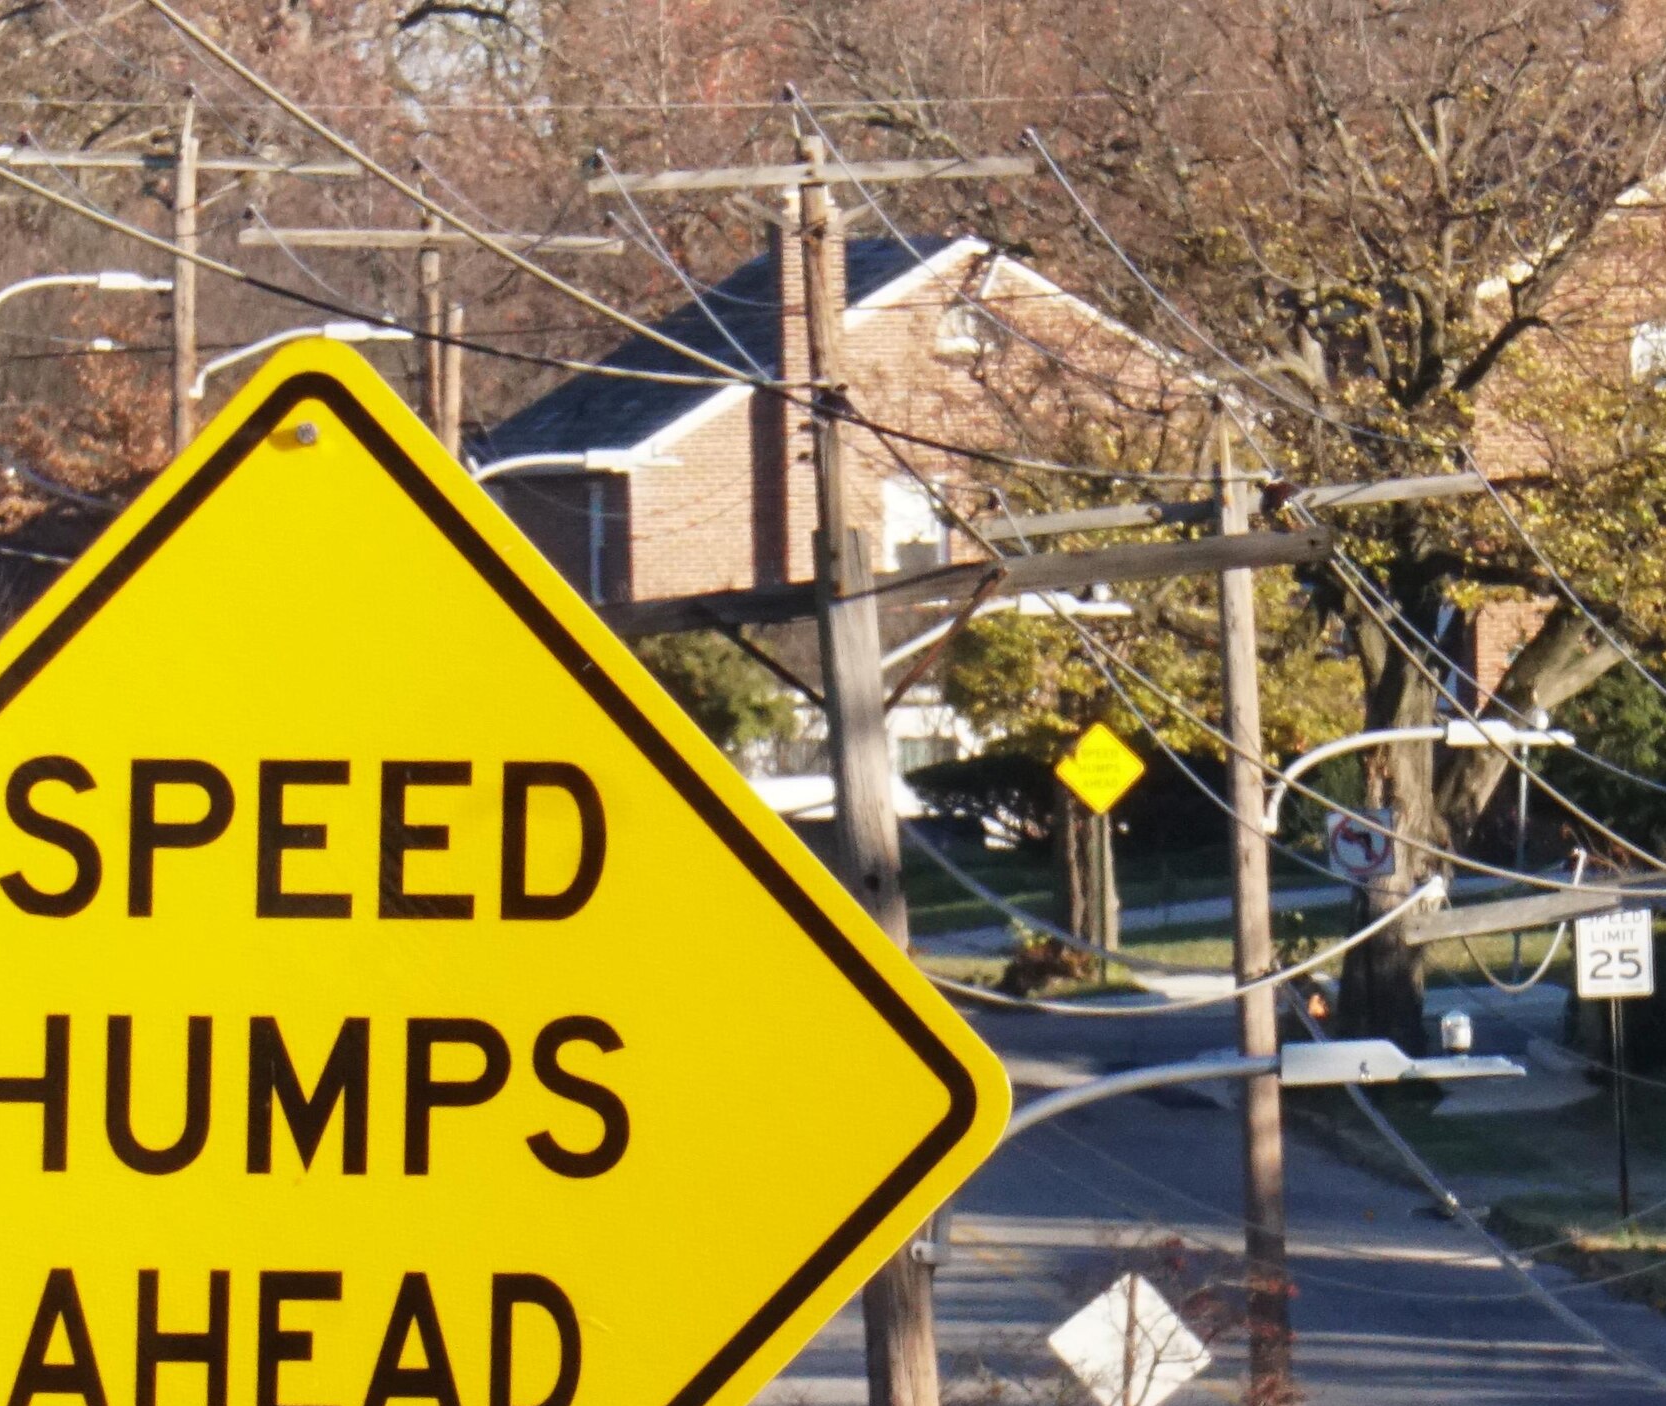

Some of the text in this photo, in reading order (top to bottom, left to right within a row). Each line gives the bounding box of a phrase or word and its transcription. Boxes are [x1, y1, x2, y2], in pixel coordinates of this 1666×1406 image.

[0, 757, 606, 920] SPEED
[1591, 929, 1636, 944] LIMIT
[1589, 949, 1642, 980] 25
